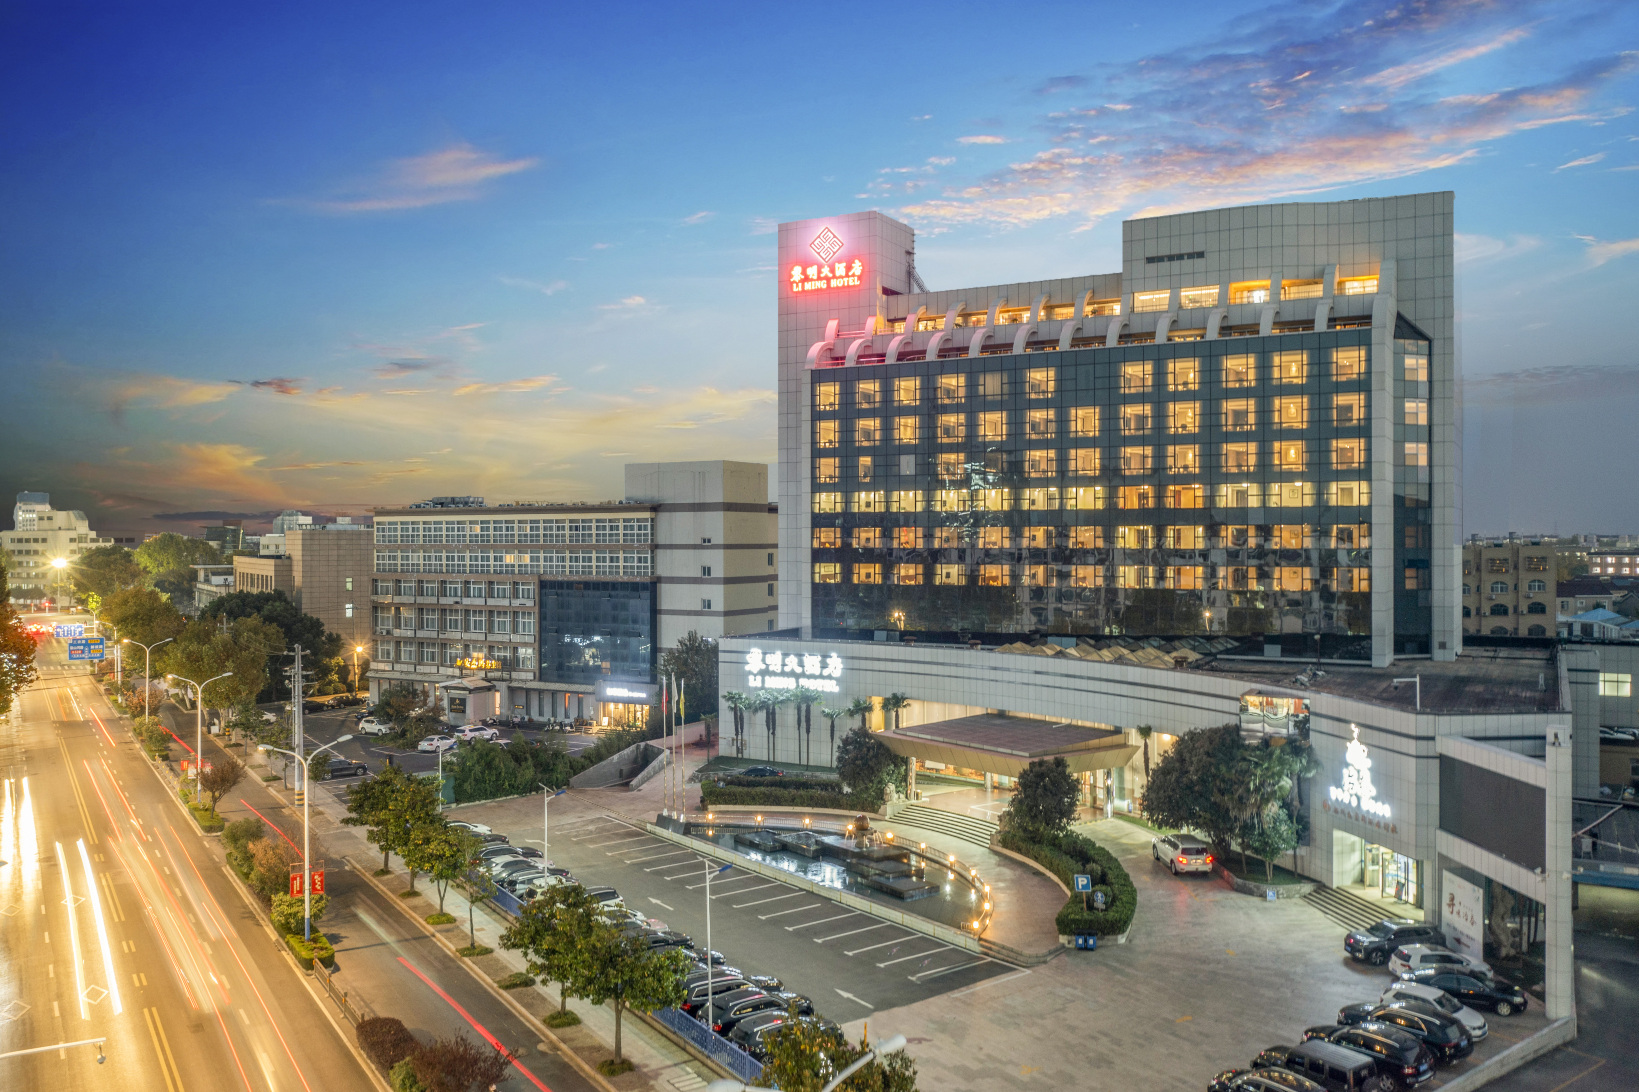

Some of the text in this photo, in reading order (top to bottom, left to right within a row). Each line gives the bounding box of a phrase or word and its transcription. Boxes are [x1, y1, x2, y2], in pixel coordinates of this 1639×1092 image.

[791, 259, 863, 283] 黎明大酒店
[793, 276, 860, 292] LI MING HOTEL
[1078, 877, 1088, 889] P
